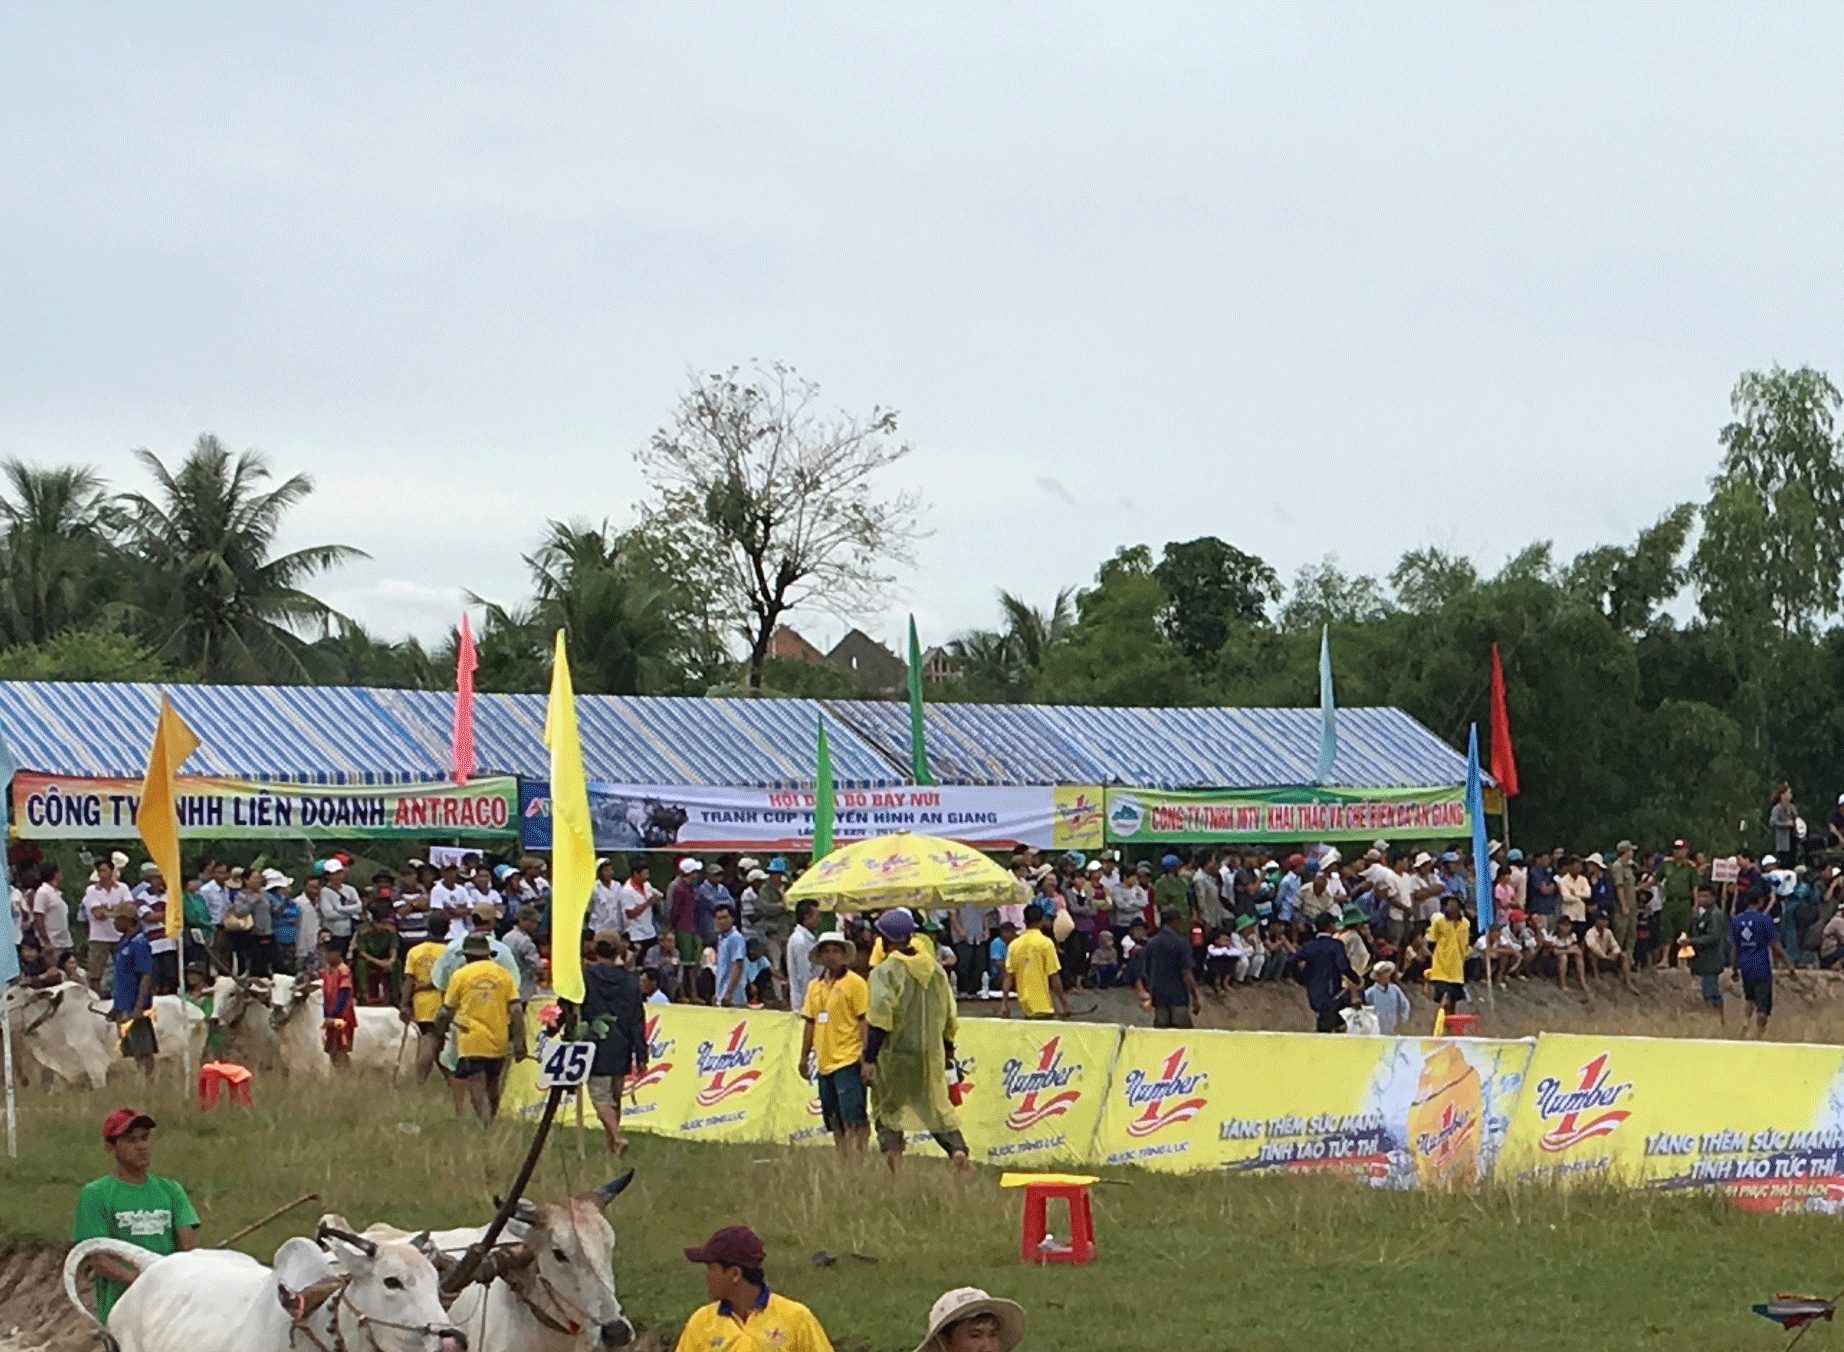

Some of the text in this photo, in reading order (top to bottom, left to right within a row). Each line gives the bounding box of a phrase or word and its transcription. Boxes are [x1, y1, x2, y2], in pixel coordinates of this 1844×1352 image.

[27, 786, 101, 826] CÔNG
[109, 795, 141, 826] TY
[175, 796, 223, 826] NHH
[233, 788, 291, 826] LIÊN
[301, 796, 386, 827] DOANH
[393, 796, 507, 827] ANTRACO
[701, 810, 758, 824] TRANH
[920, 811, 943, 824] AN
[948, 811, 998, 824] GIANG
[543, 1044, 590, 1082] 45
[697, 1020, 763, 1090] Number 1
[1002, 1035, 1082, 1113] Number 1
[1125, 1046, 1208, 1123] Number 1
[1537, 1053, 1633, 1135] Number 1
